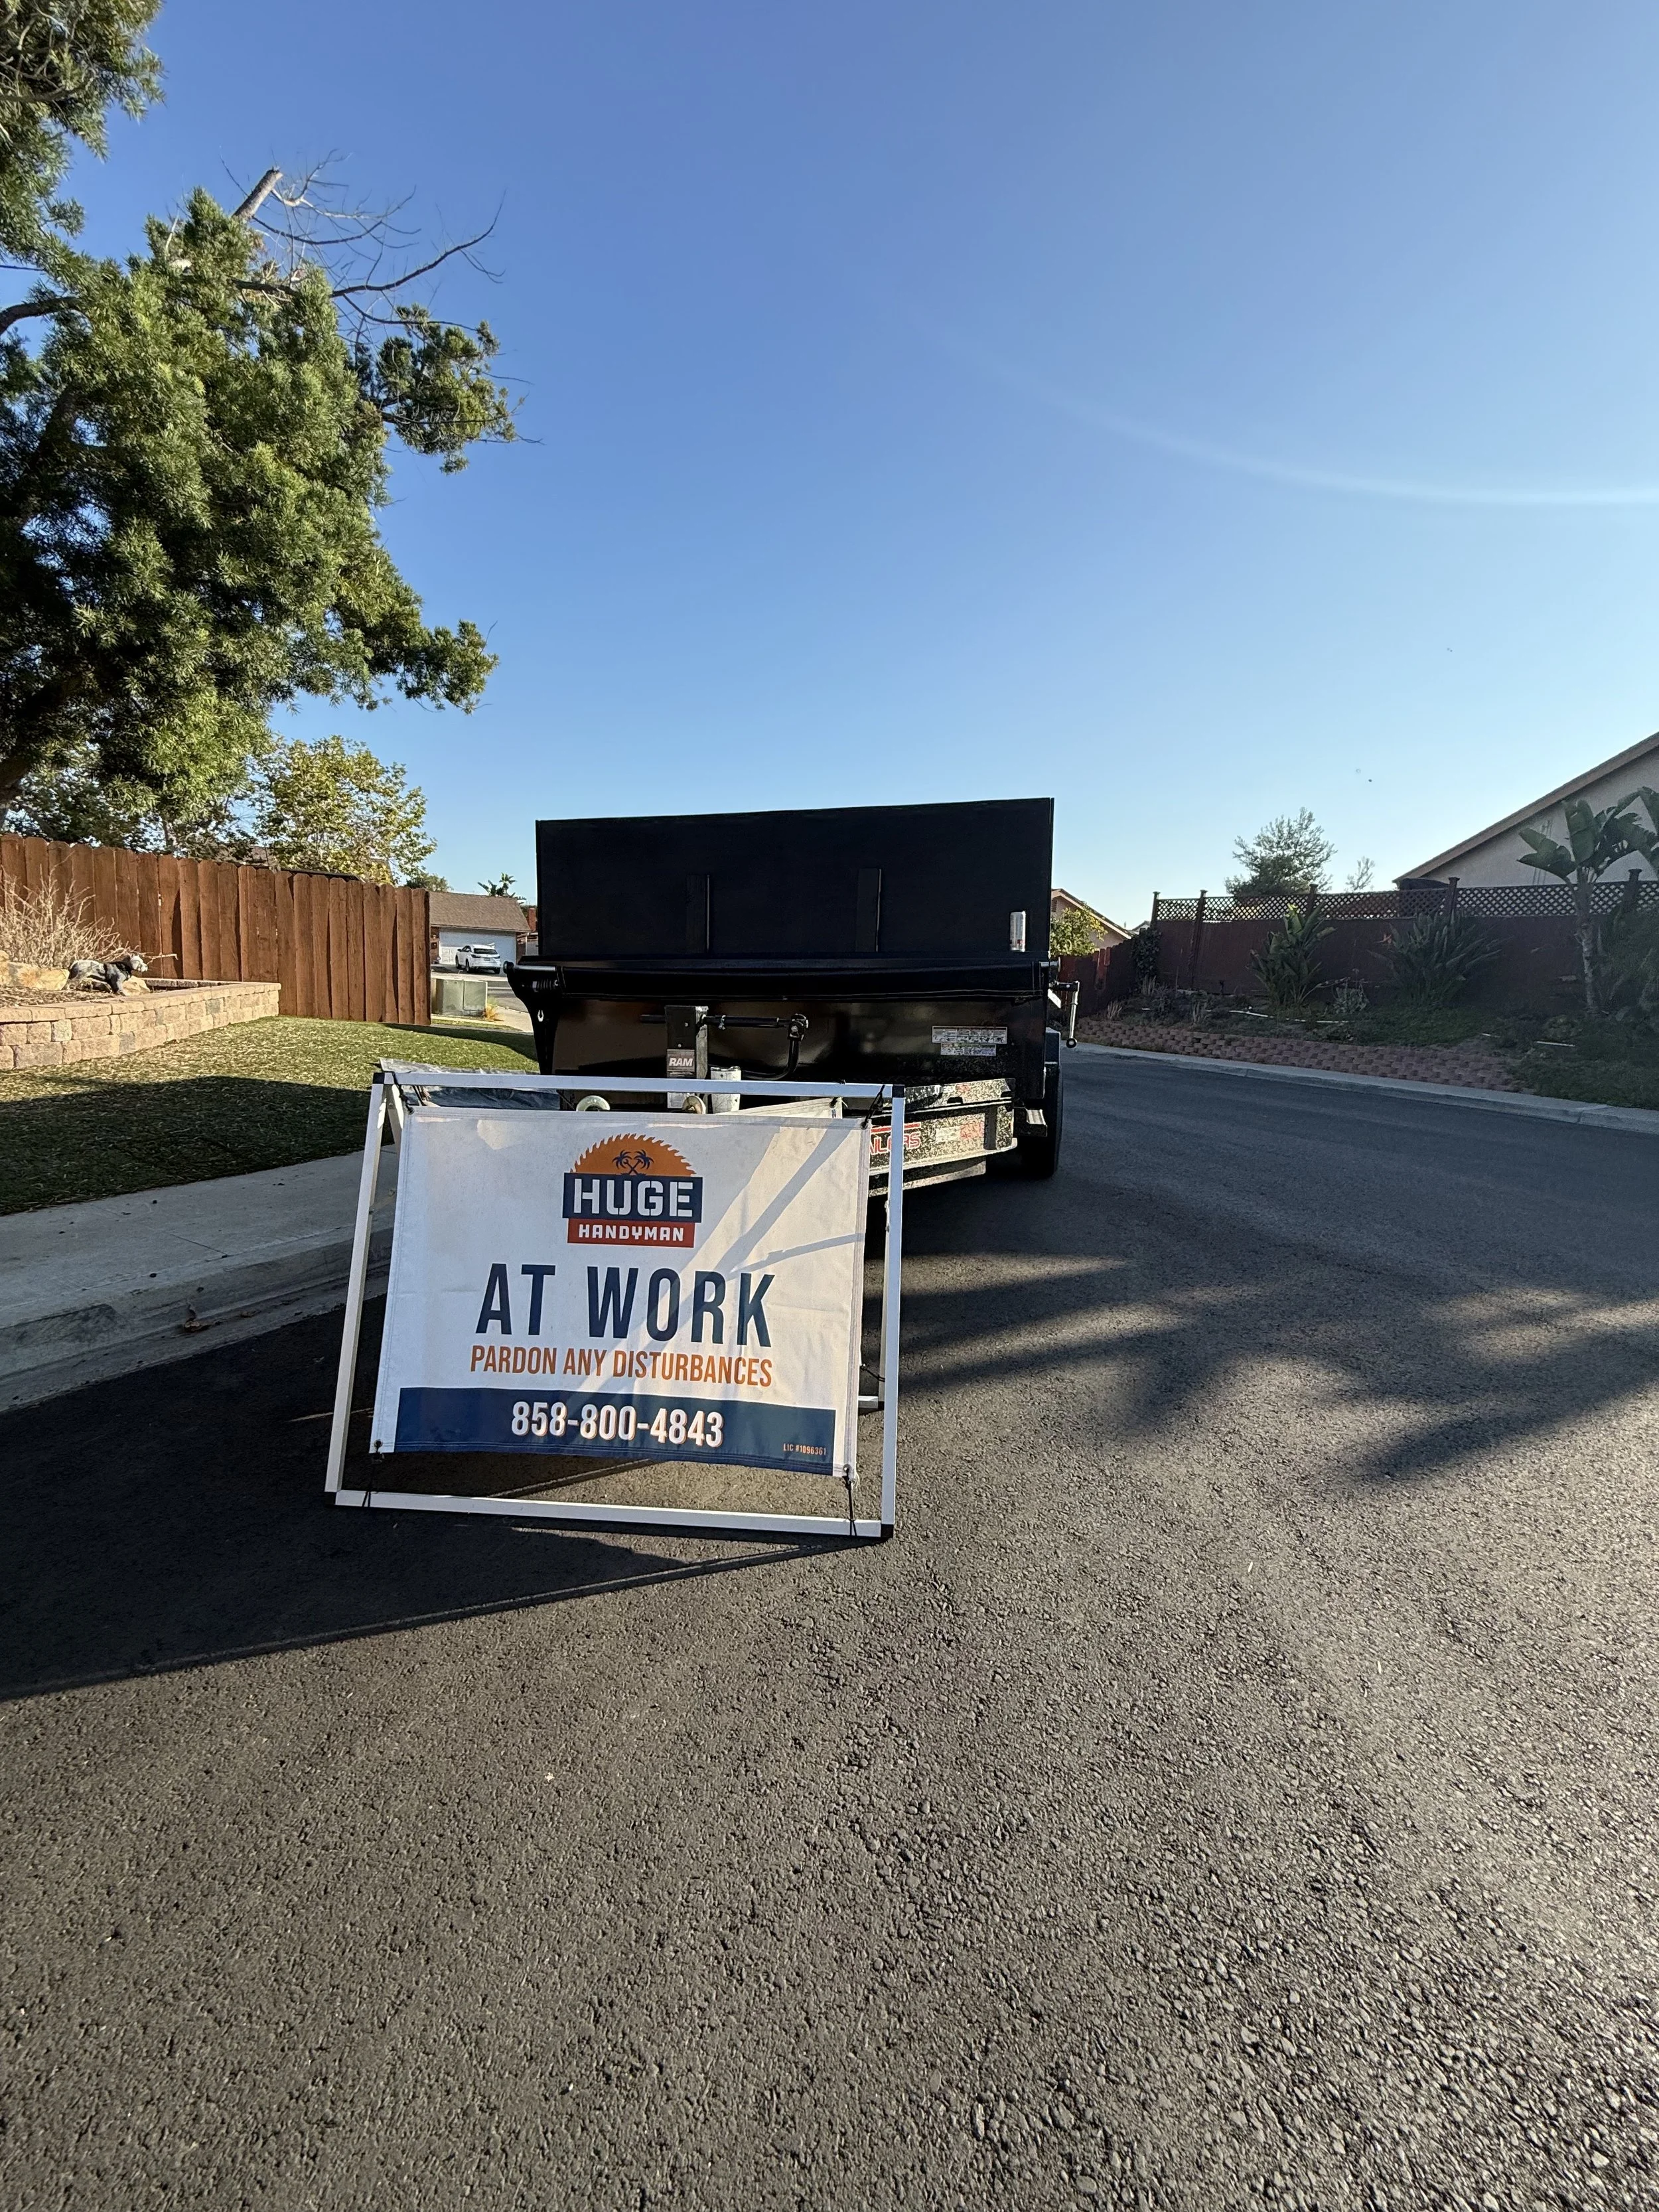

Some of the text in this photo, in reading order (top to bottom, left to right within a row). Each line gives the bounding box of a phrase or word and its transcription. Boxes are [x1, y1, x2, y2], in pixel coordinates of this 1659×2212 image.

[669, 1057, 693, 1067] RAM
[573, 1178, 693, 1217] HUGE
[579, 1224, 684, 1242] HANDYMAN
[475, 1263, 776, 1347] AT WORK
[470, 1345, 773, 1387] PARDON ANY DISTURBANCES
[511, 1401, 724, 1448] 858-800-4843
[783, 1443, 827, 1455] LIC #1096361
